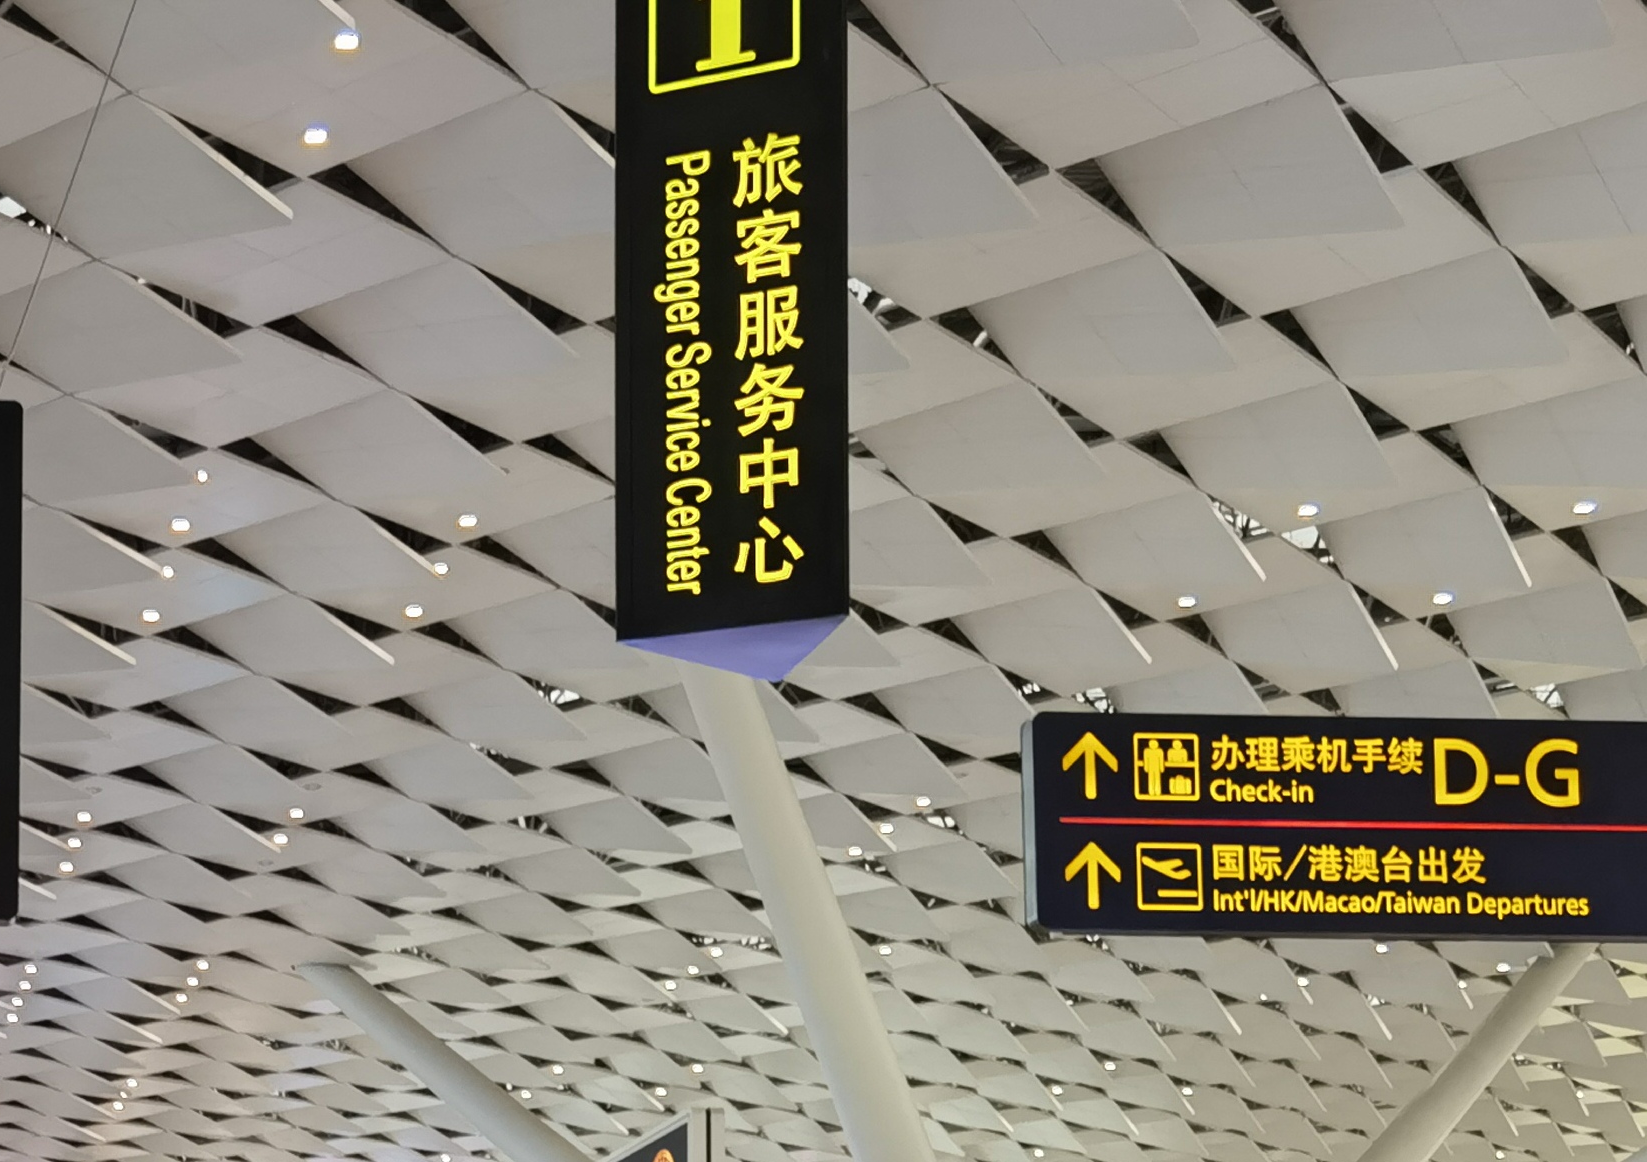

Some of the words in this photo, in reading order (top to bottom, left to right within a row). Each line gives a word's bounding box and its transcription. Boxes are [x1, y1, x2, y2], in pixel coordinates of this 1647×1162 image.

[654, 150, 711, 334] Passenger
[665, 341, 712, 472] Service
[732, 132, 804, 583] 旅客服务中心
[665, 478, 712, 595] Center
[1209, 778, 1314, 804] Check-in
[1210, 735, 1423, 776] 办理乘机手续
[1433, 738, 1581, 808] D-G
[1212, 889, 1461, 916] Int'l/HK/Macao/Taiwan
[1466, 892, 1590, 918] Departures
